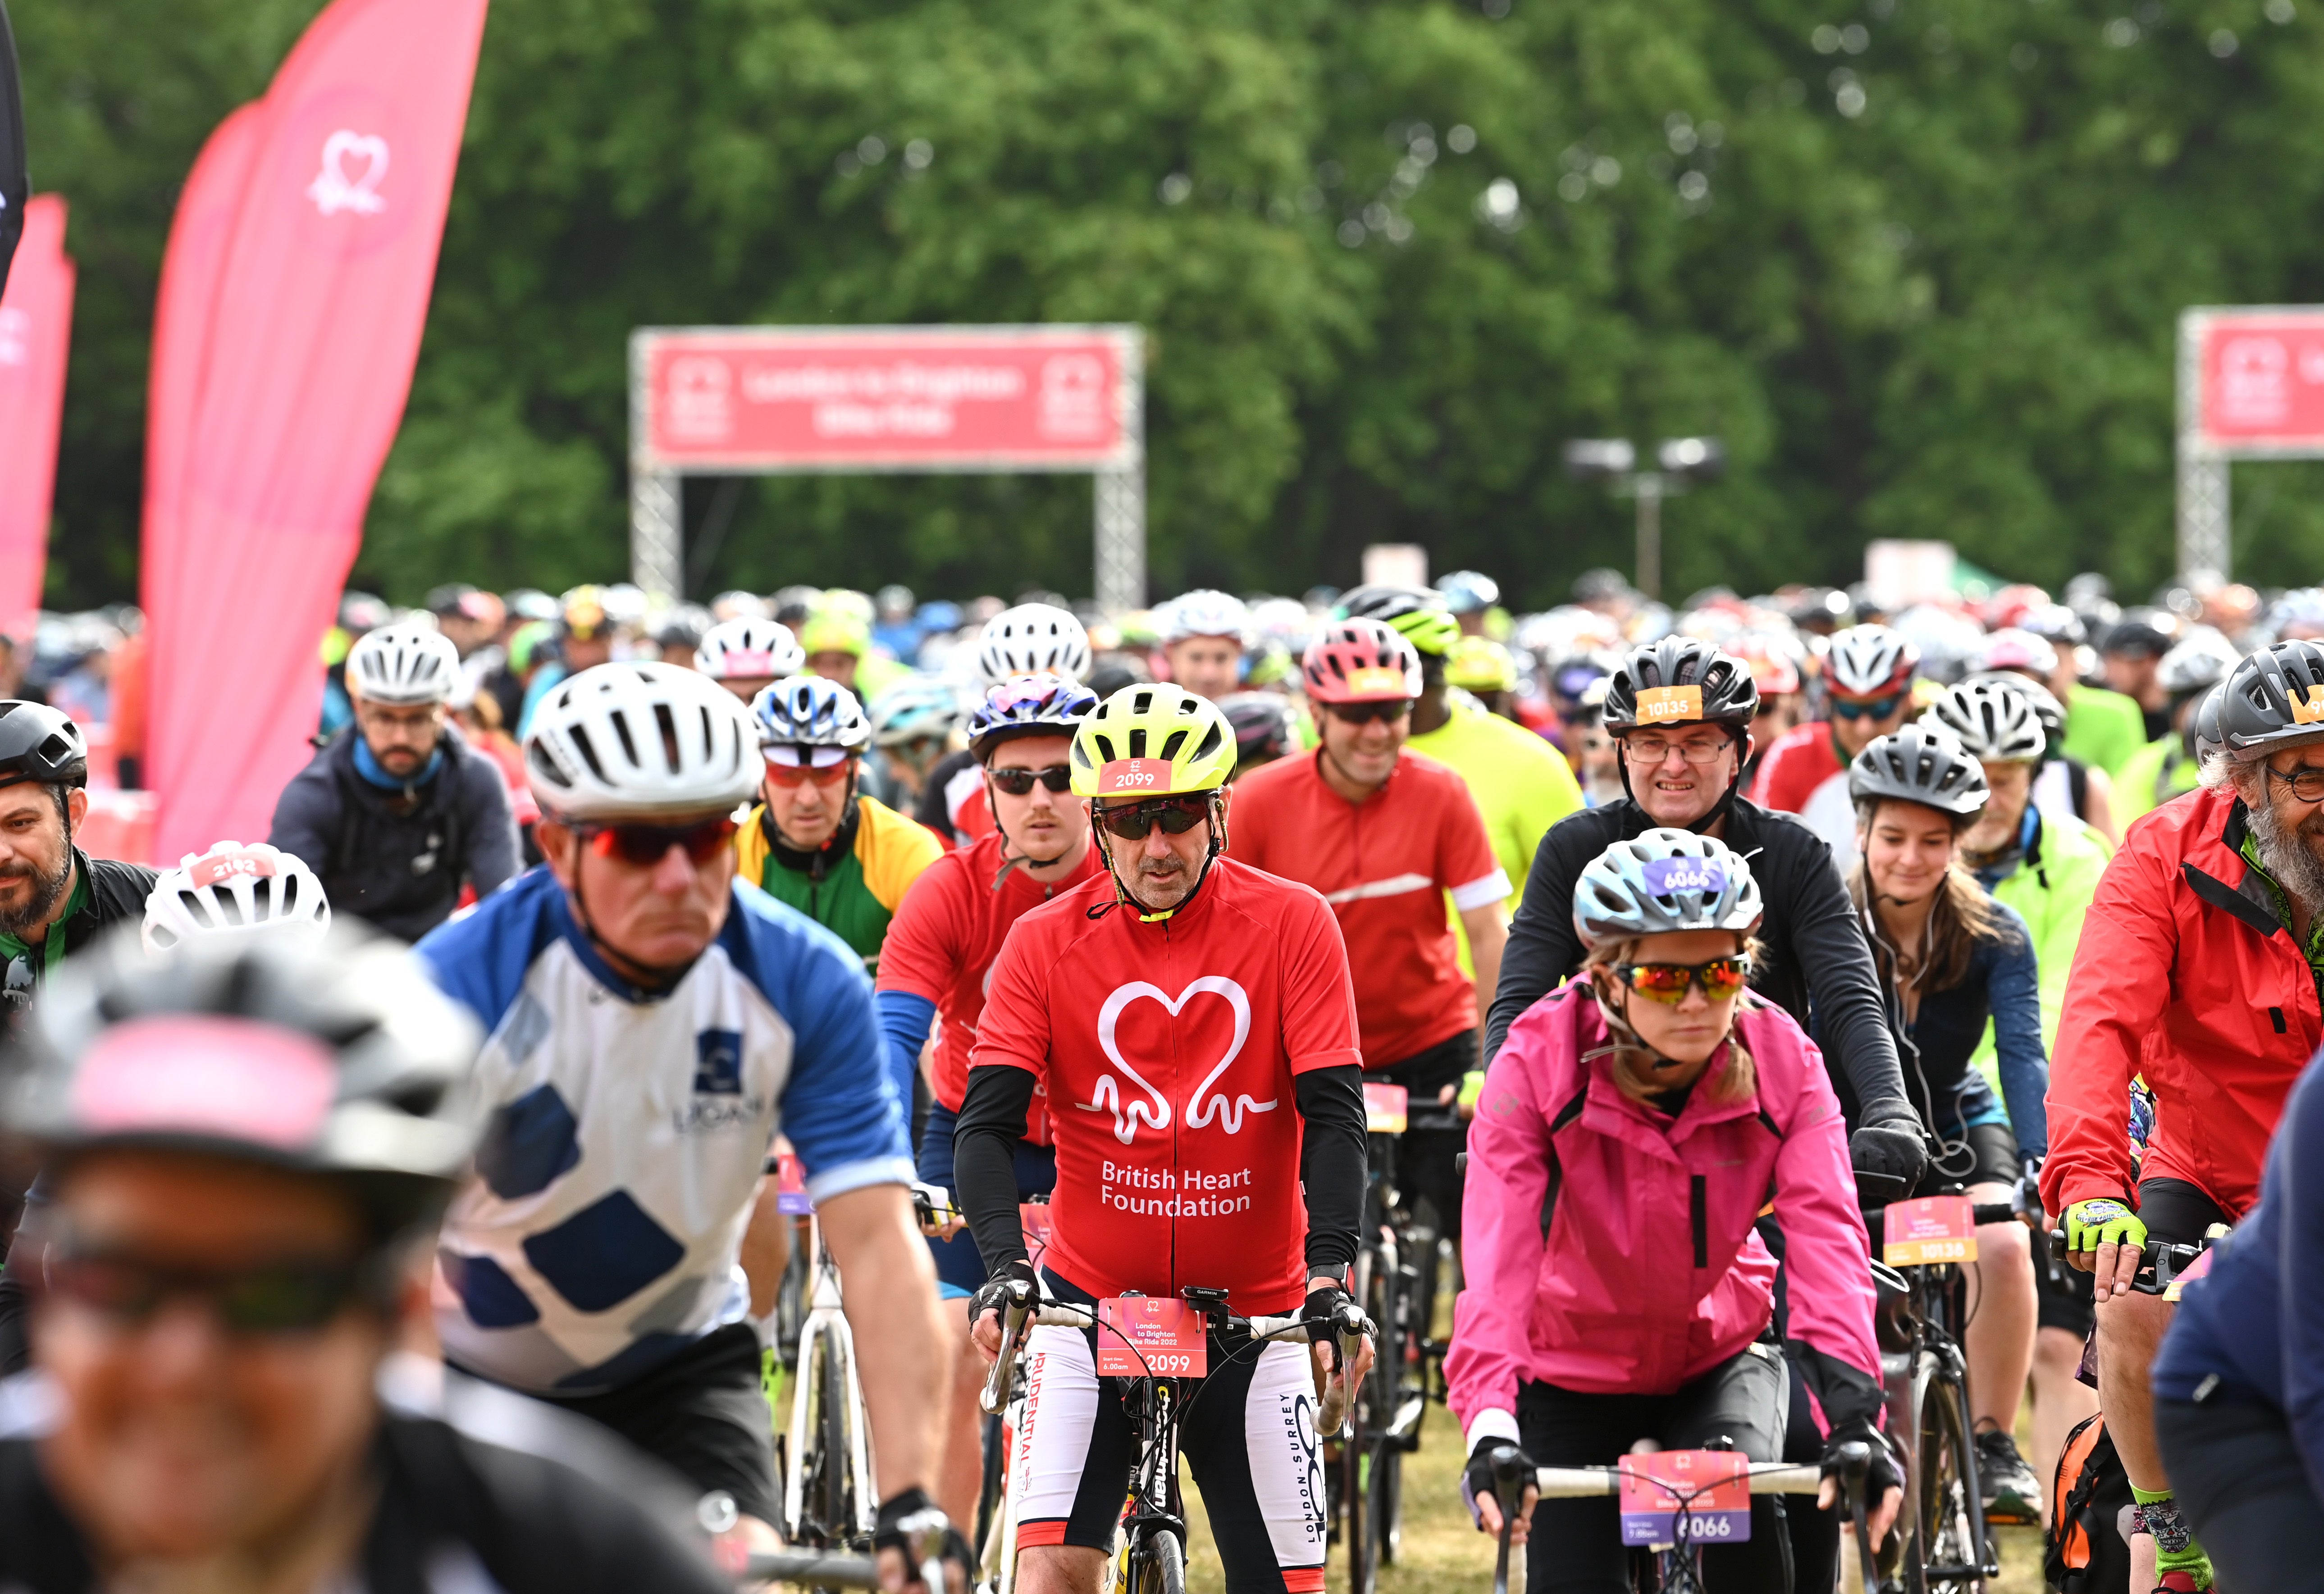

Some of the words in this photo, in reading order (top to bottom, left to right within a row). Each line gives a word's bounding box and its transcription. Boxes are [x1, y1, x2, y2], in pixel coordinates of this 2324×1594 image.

[1648, 700, 1688, 717] 10135
[1115, 773, 1154, 788] 2099
[1664, 870, 1710, 889] 6066
[1102, 1160, 1175, 1189] British
[1184, 1167, 1251, 1190] Heart
[1102, 1184, 1250, 1217] Foundation
[1146, 1355, 1190, 1371] 2099
